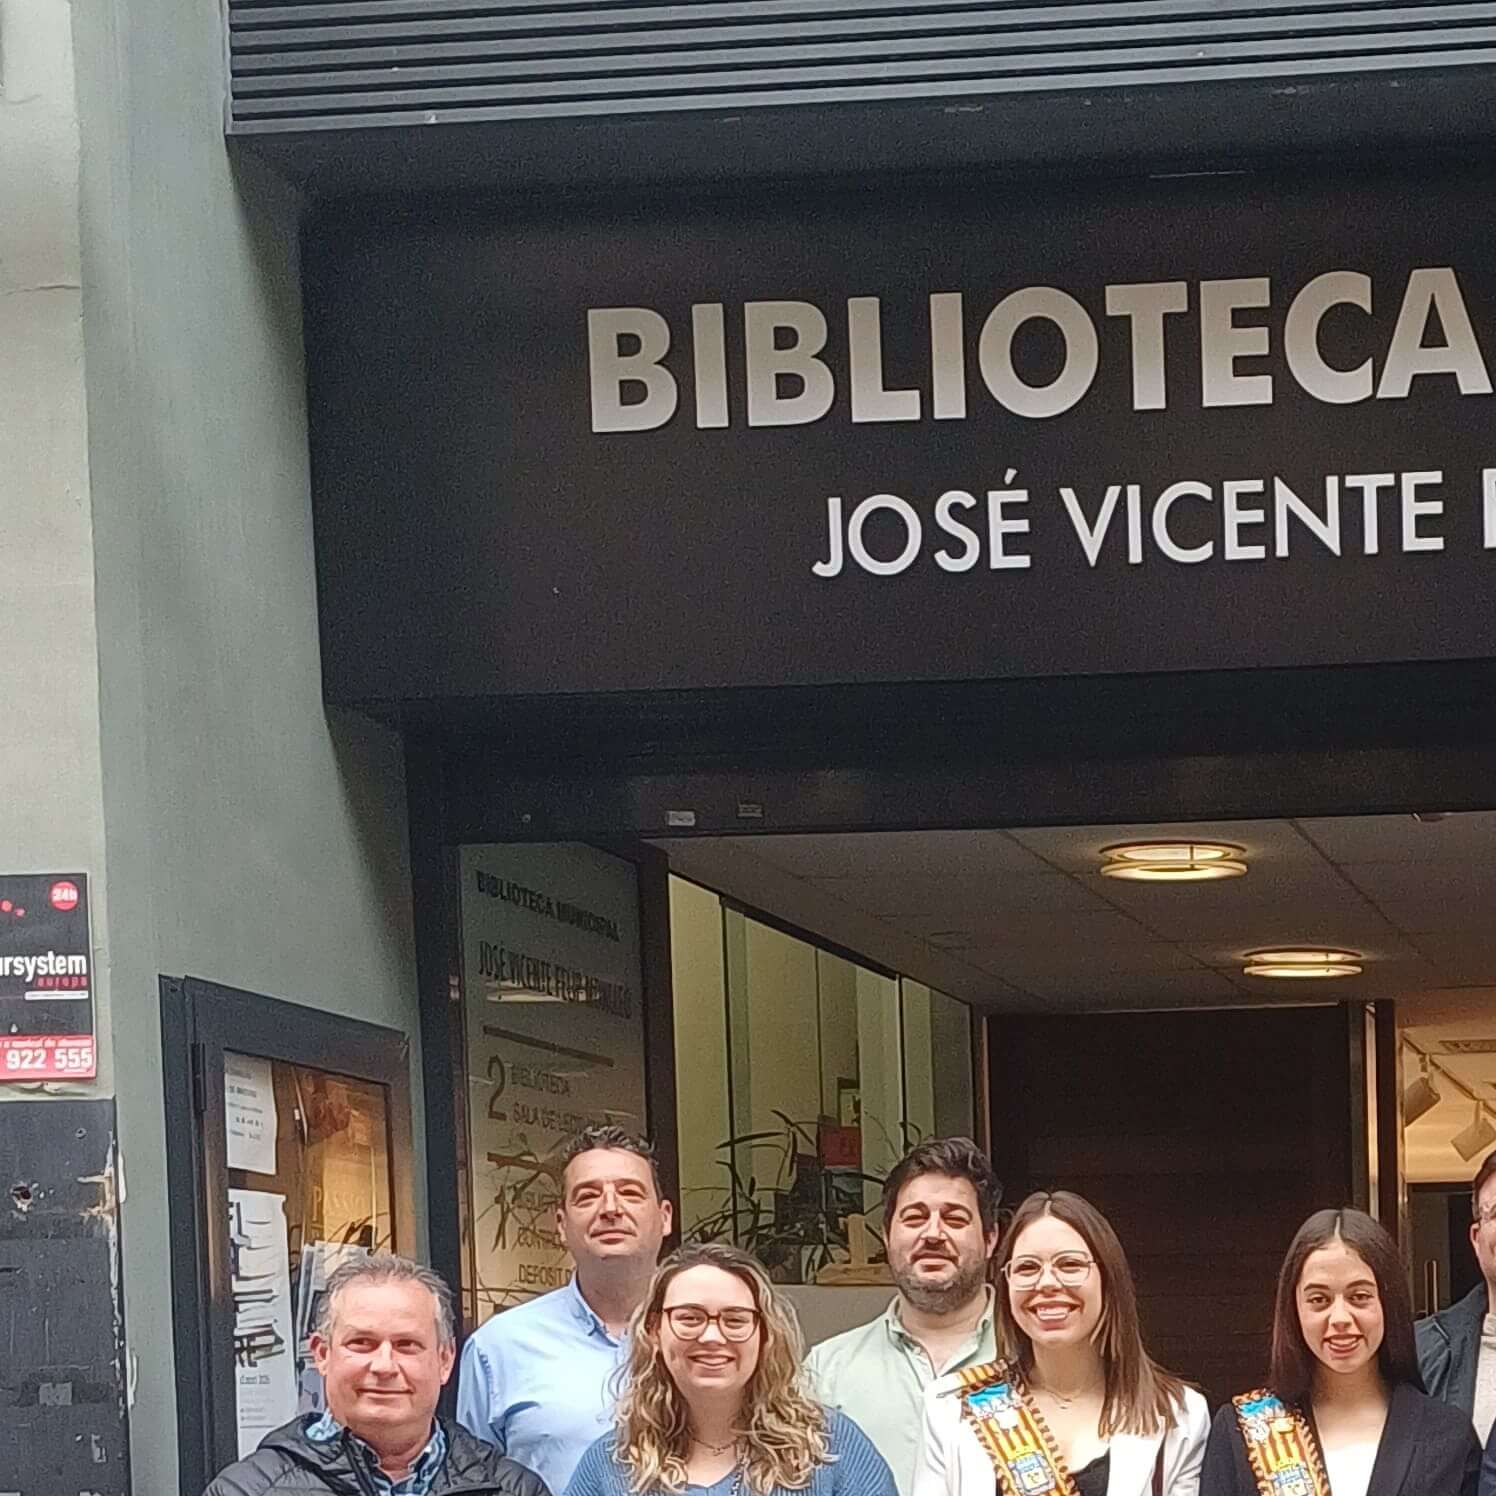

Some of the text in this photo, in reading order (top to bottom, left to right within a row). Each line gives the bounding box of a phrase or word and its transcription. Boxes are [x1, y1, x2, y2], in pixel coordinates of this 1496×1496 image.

[587, 267, 1494, 433] BIBLIOTECA
[811, 468, 1032, 578] JOSÉ
[1058, 470, 1445, 567] VICENTE
[6, 1048, 92, 1069] 922 555
[487, 1055, 507, 1121] 2
